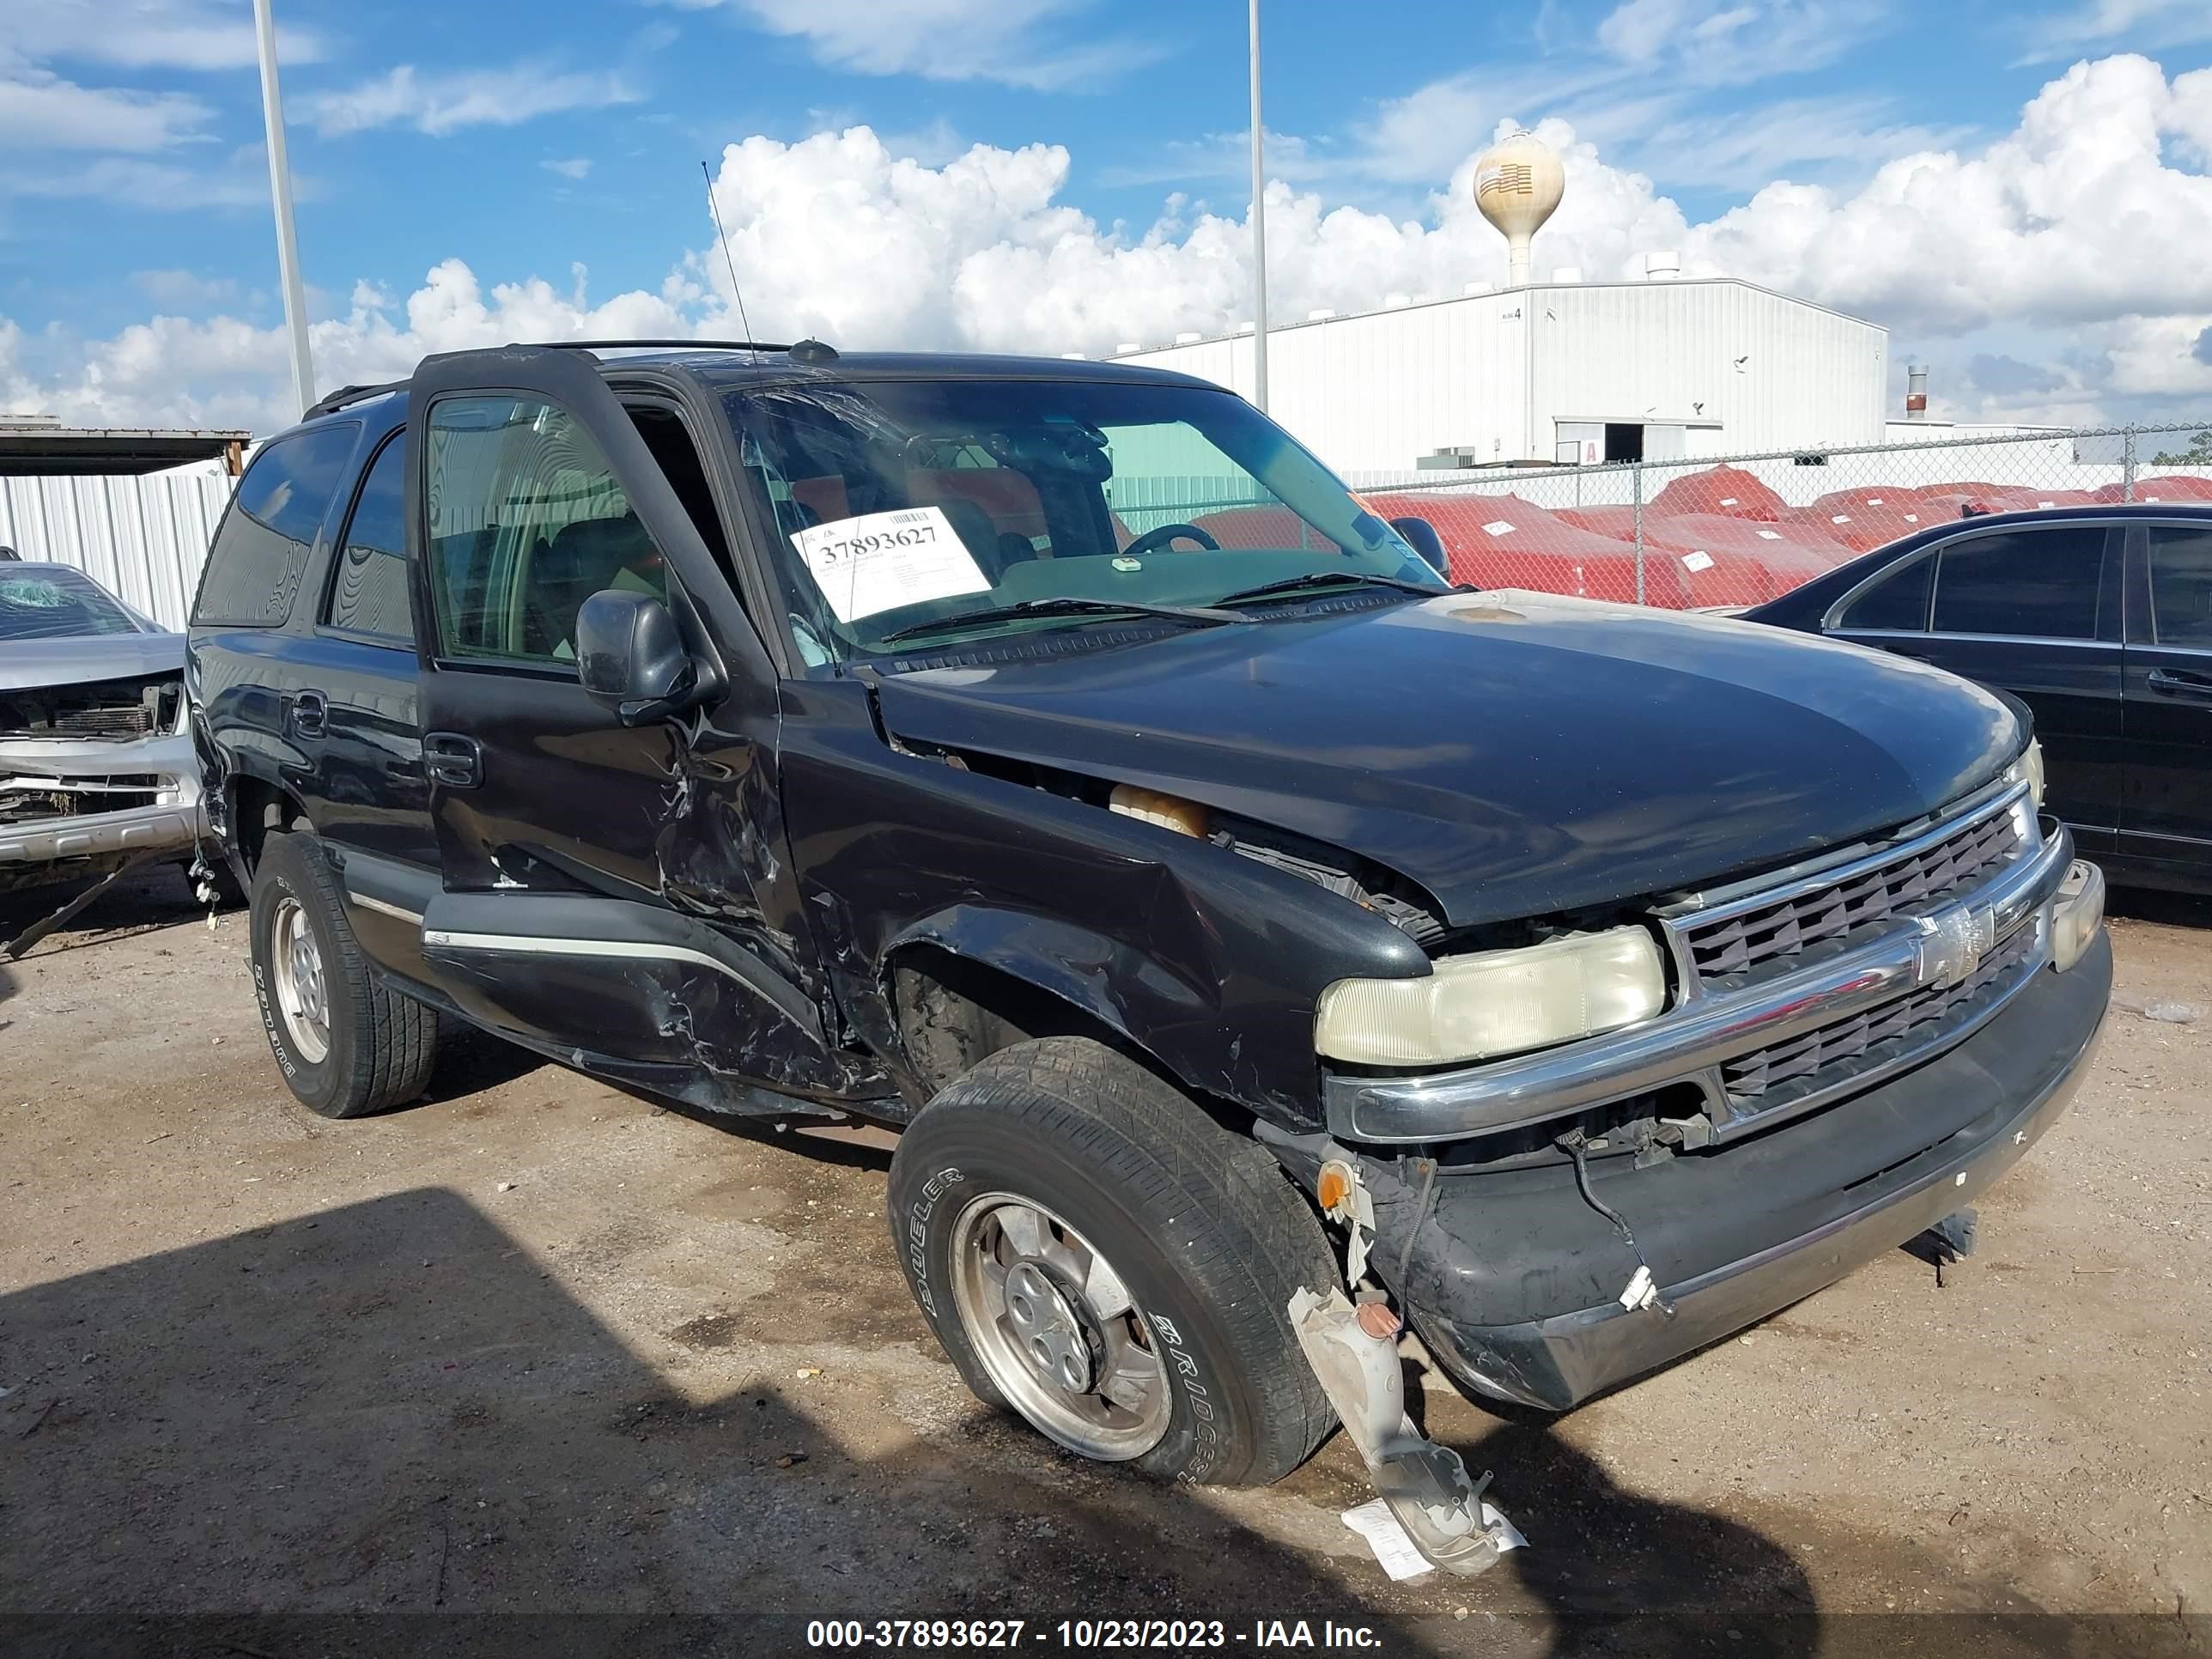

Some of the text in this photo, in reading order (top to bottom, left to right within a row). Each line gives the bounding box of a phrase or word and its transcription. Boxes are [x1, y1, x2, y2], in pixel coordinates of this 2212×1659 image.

[1514, 307, 1521, 320] 4
[1586, 442, 1596, 462] A
[819, 526, 936, 563] 37893627
[253, 963, 296, 1079] DUELER
[909, 1167, 965, 1319] DUELER
